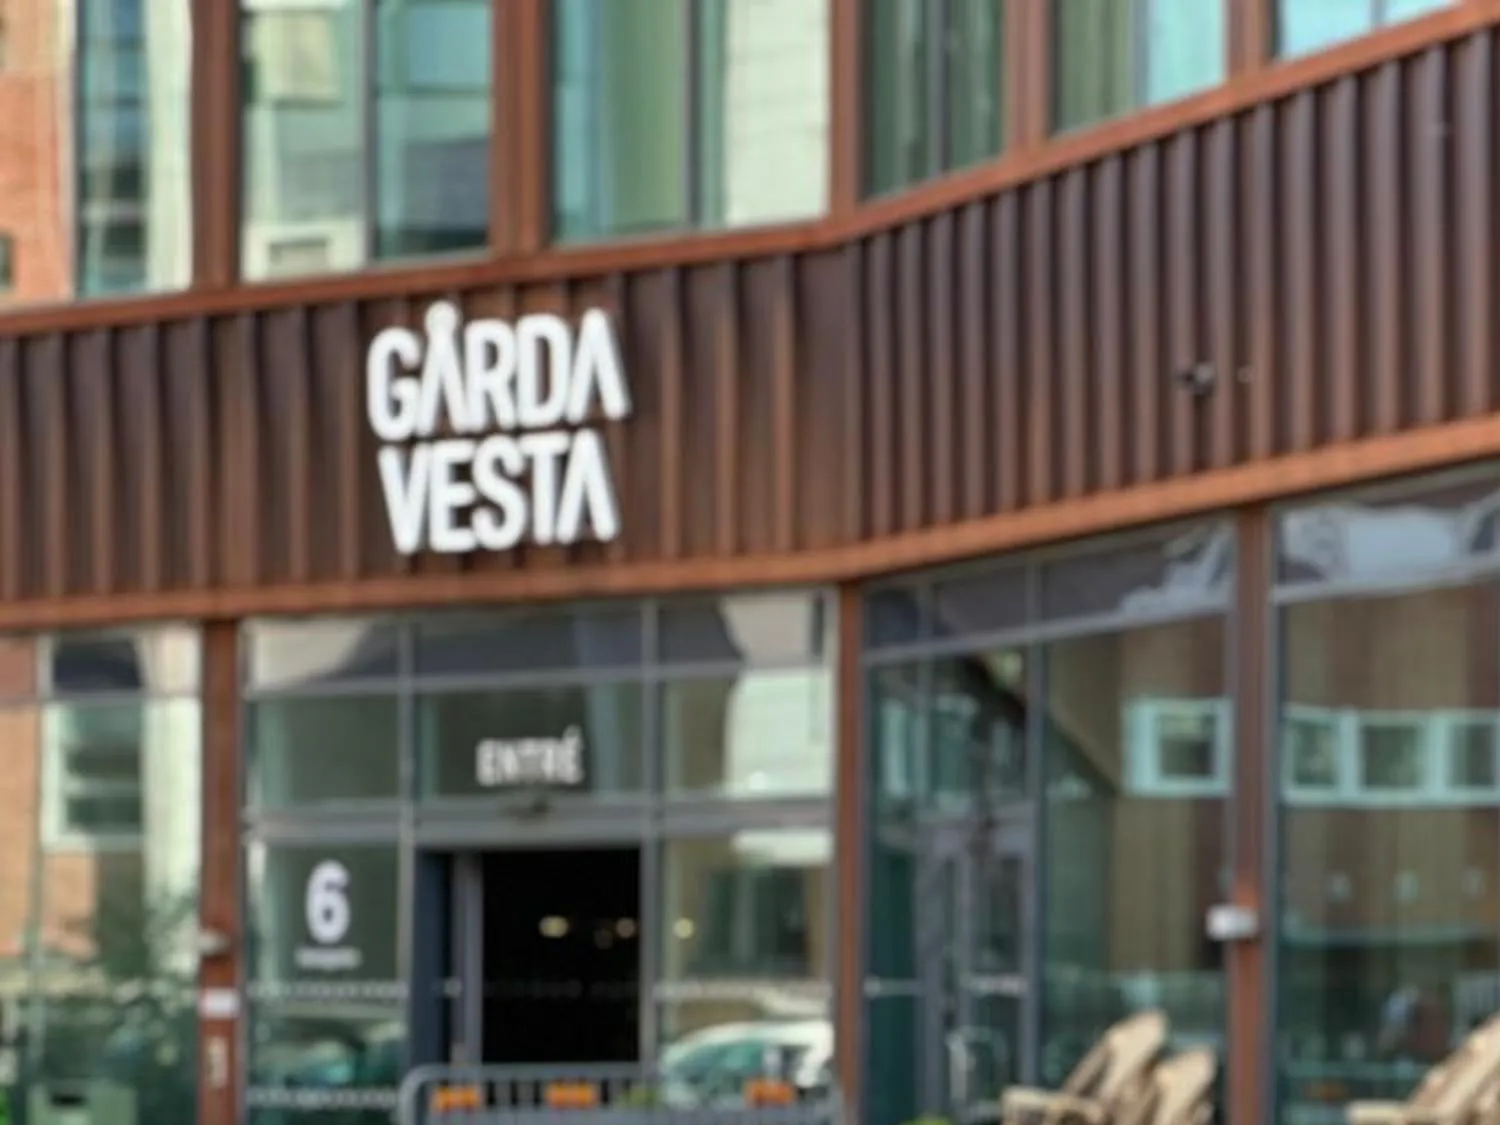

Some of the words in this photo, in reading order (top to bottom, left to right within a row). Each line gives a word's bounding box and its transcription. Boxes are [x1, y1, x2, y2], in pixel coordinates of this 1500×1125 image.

[366, 301, 631, 441] GÅRDA
[378, 428, 619, 554] VESTA
[476, 725, 584, 787] ENTRÉ
[305, 859, 350, 943] 6
